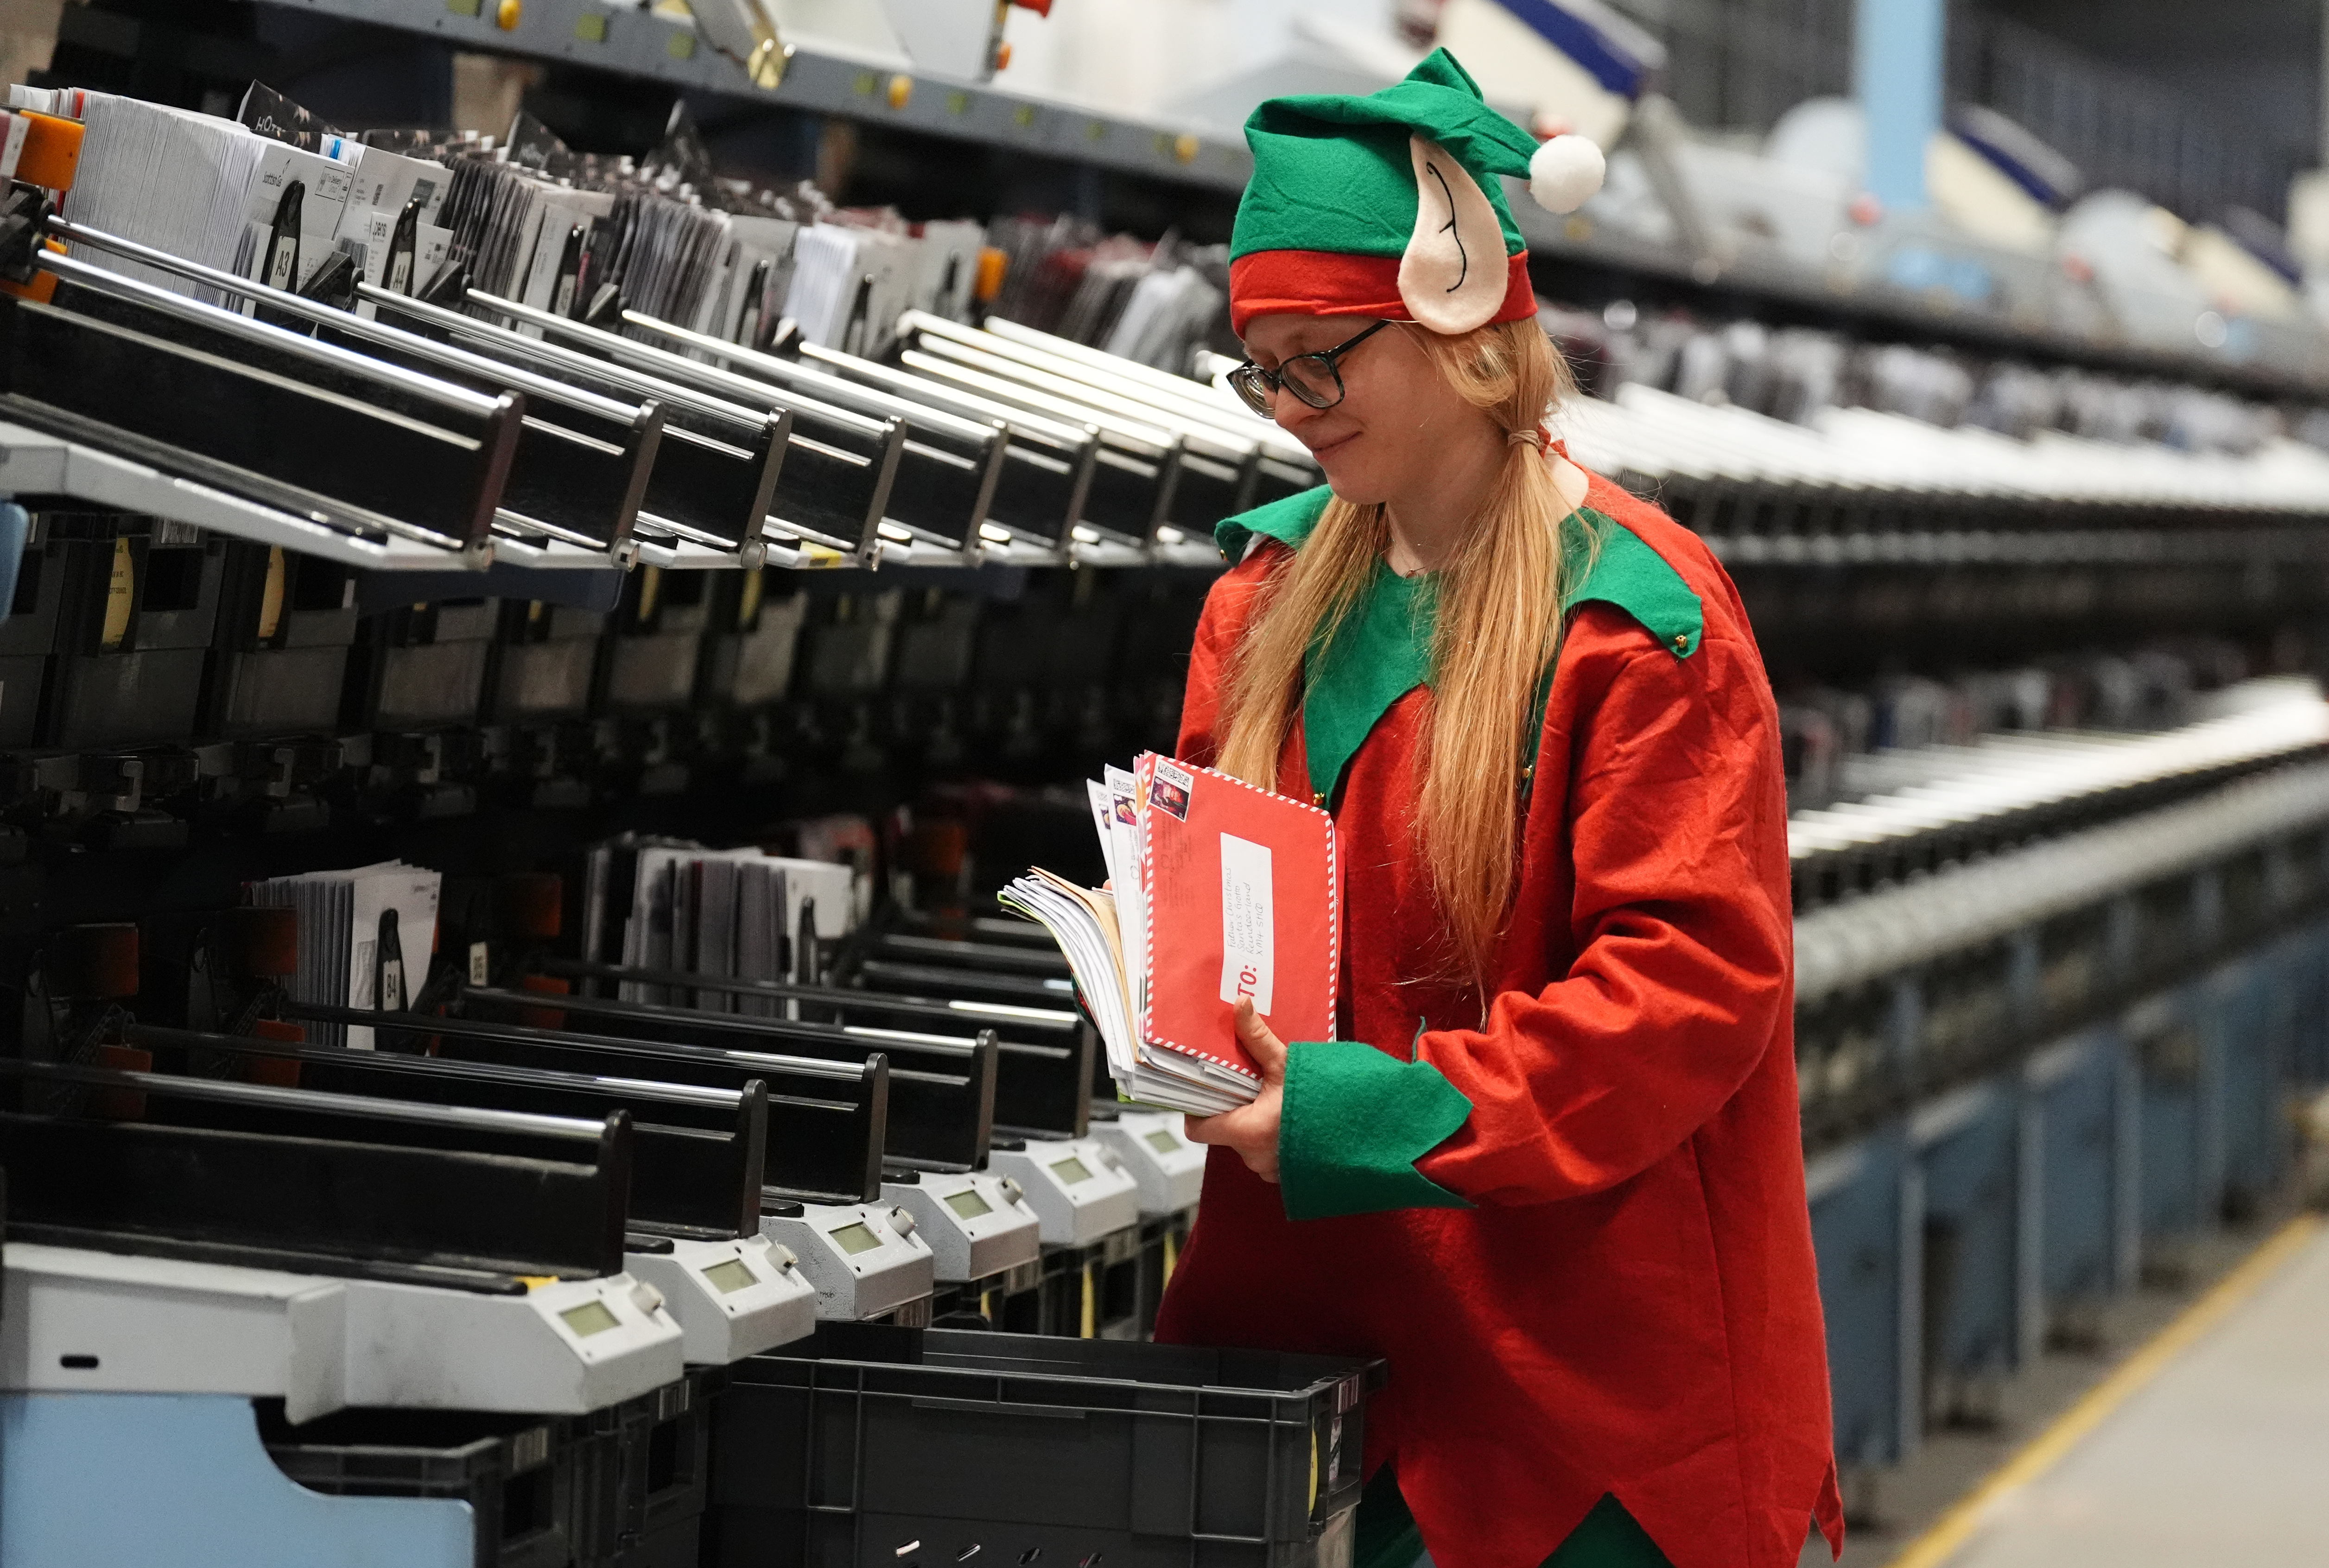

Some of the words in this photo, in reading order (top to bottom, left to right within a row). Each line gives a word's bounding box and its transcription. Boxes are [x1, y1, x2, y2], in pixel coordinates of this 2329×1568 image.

[276, 251, 289, 277] A3
[393, 264, 406, 289] A4
[1225, 866, 1234, 916] Christmas
[1227, 918, 1236, 948] Father
[1234, 915, 1245, 951] Santa's
[1256, 931, 1264, 956] XM4
[1237, 965, 1257, 997] TO:
